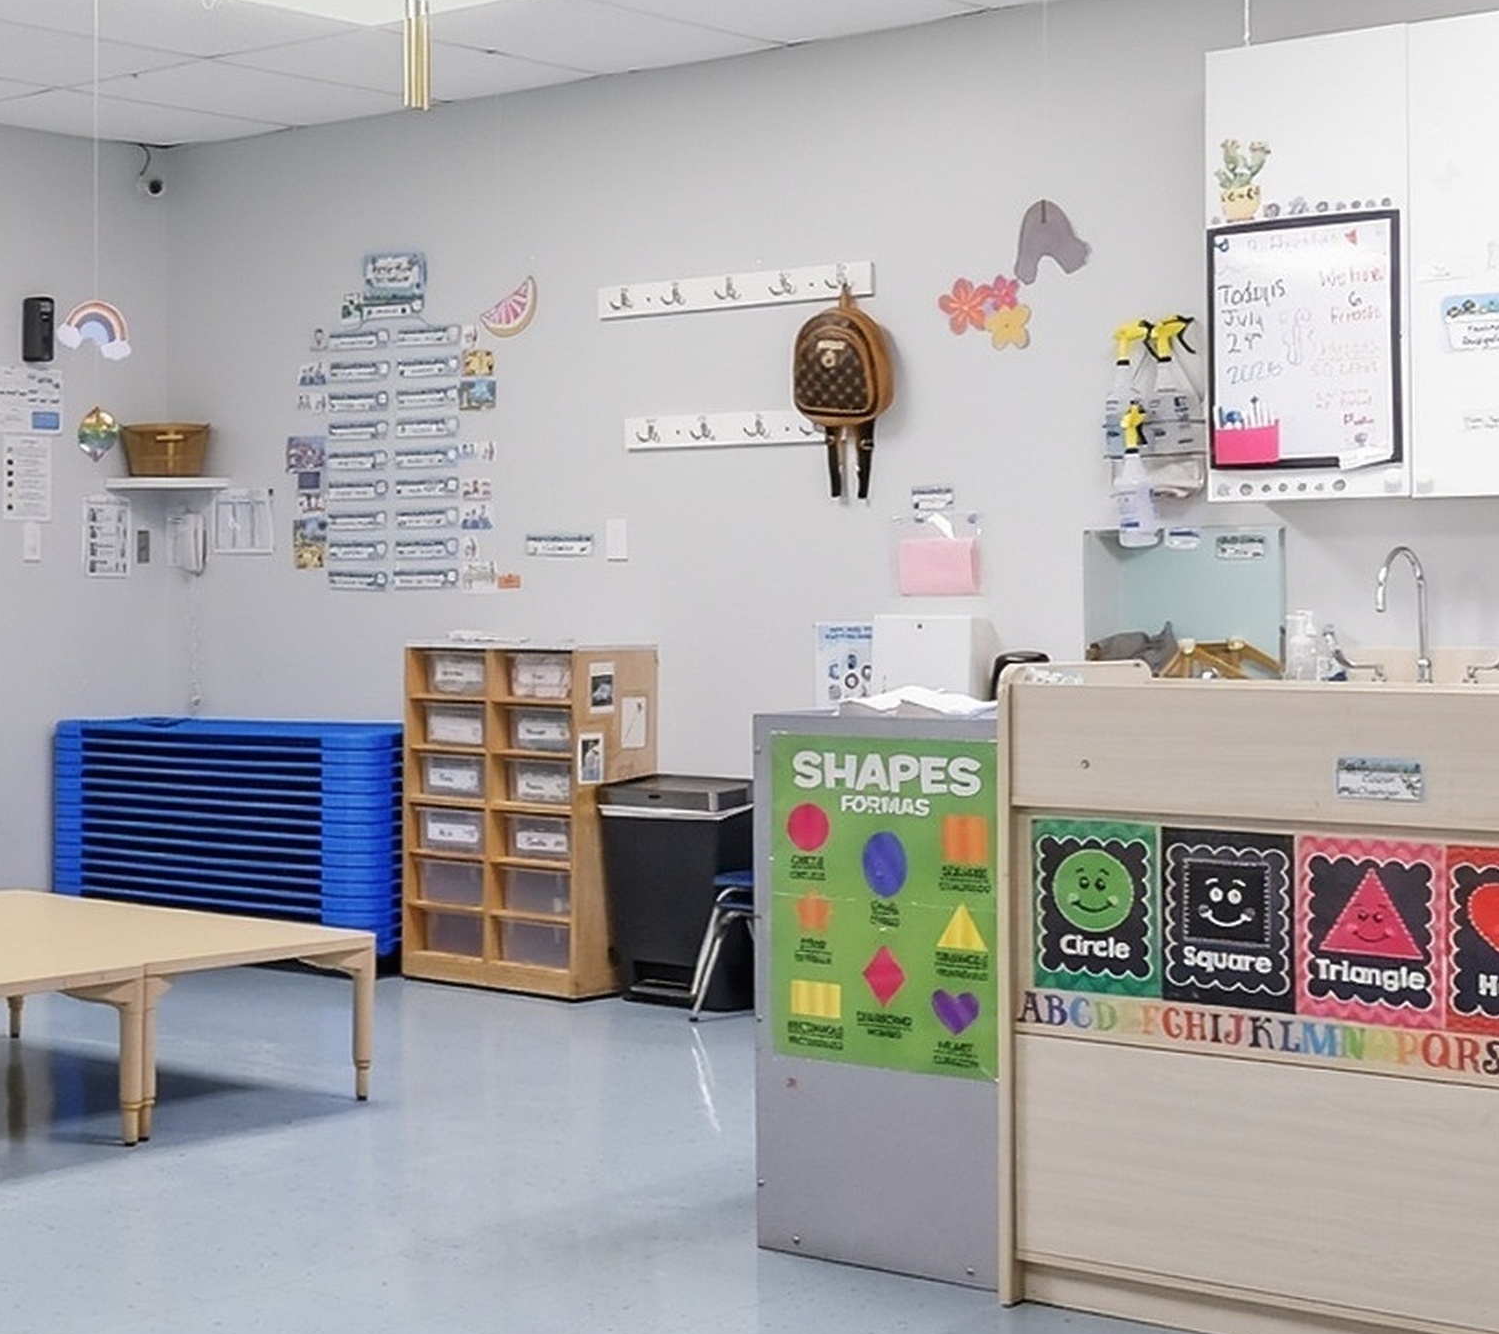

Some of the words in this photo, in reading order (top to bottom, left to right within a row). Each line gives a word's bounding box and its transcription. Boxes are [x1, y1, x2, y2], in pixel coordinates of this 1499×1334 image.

[1221, 309, 1264, 332] July
[793, 750, 982, 797] SHAPES
[841, 795, 930, 816] FORMAS
[1060, 934, 1131, 960] Circle
[1182, 945, 1273, 974] Square
[1315, 958, 1426, 992] Triangle
